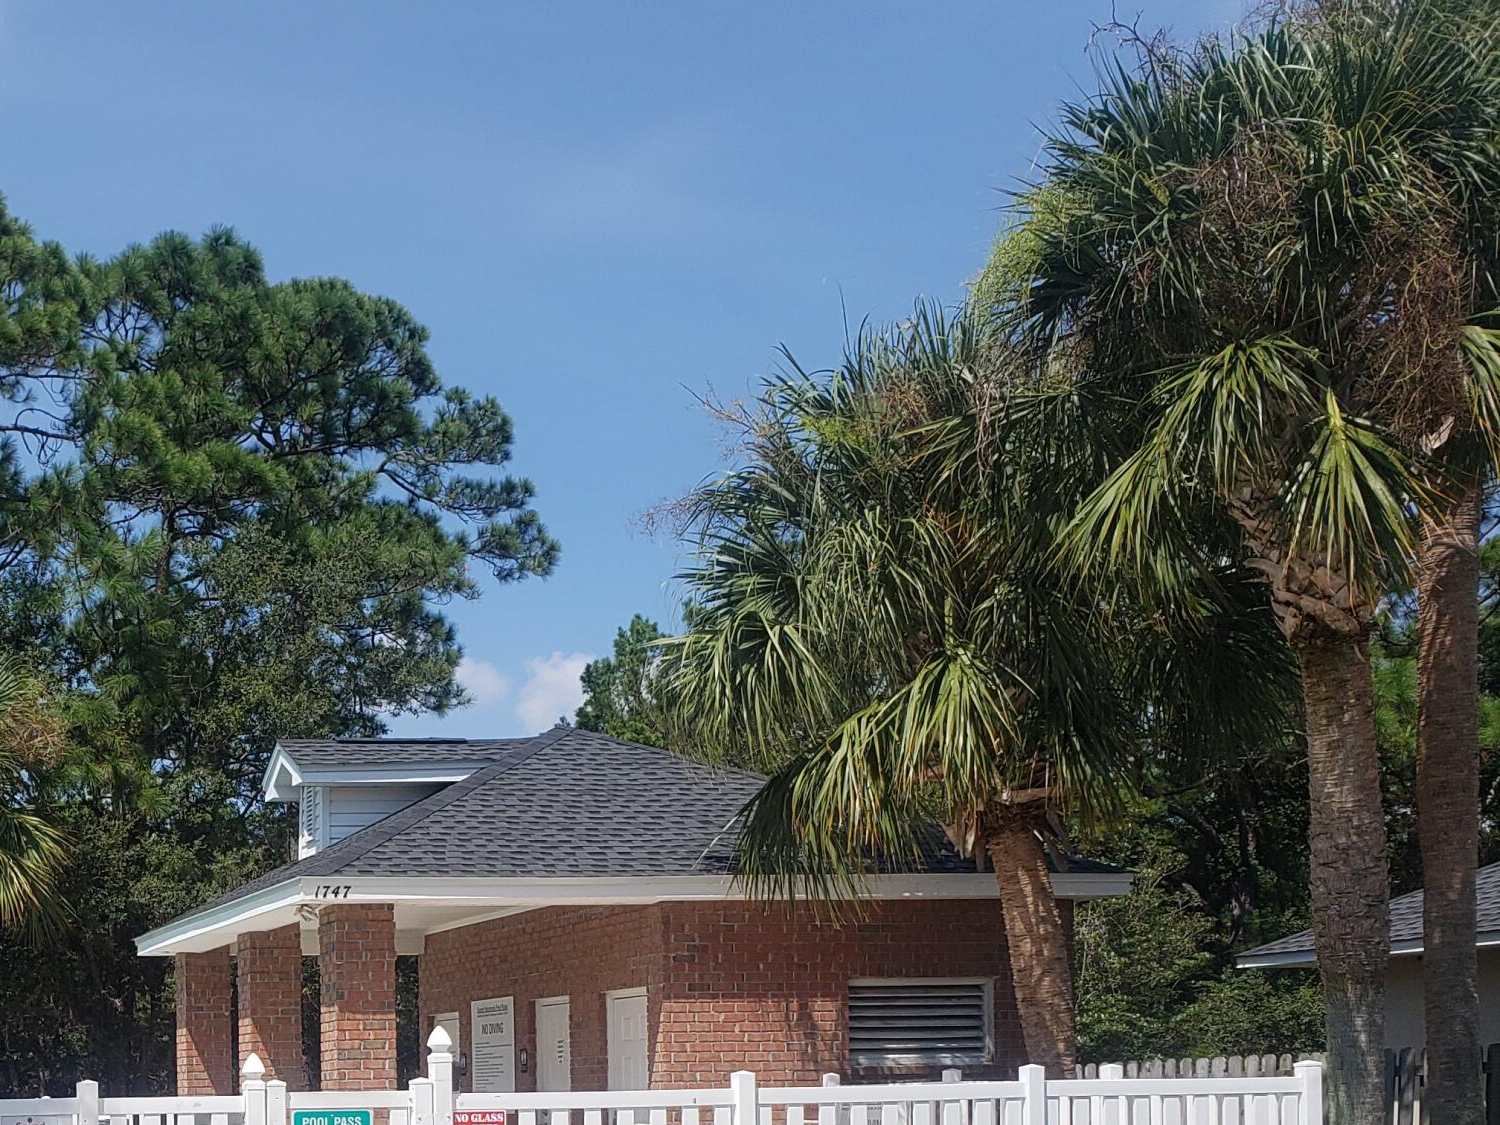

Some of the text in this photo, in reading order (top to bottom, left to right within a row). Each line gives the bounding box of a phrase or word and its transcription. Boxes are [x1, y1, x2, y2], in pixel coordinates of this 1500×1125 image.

[315, 885, 352, 898] 1747
[454, 1113, 503, 1122] NO GLASS
